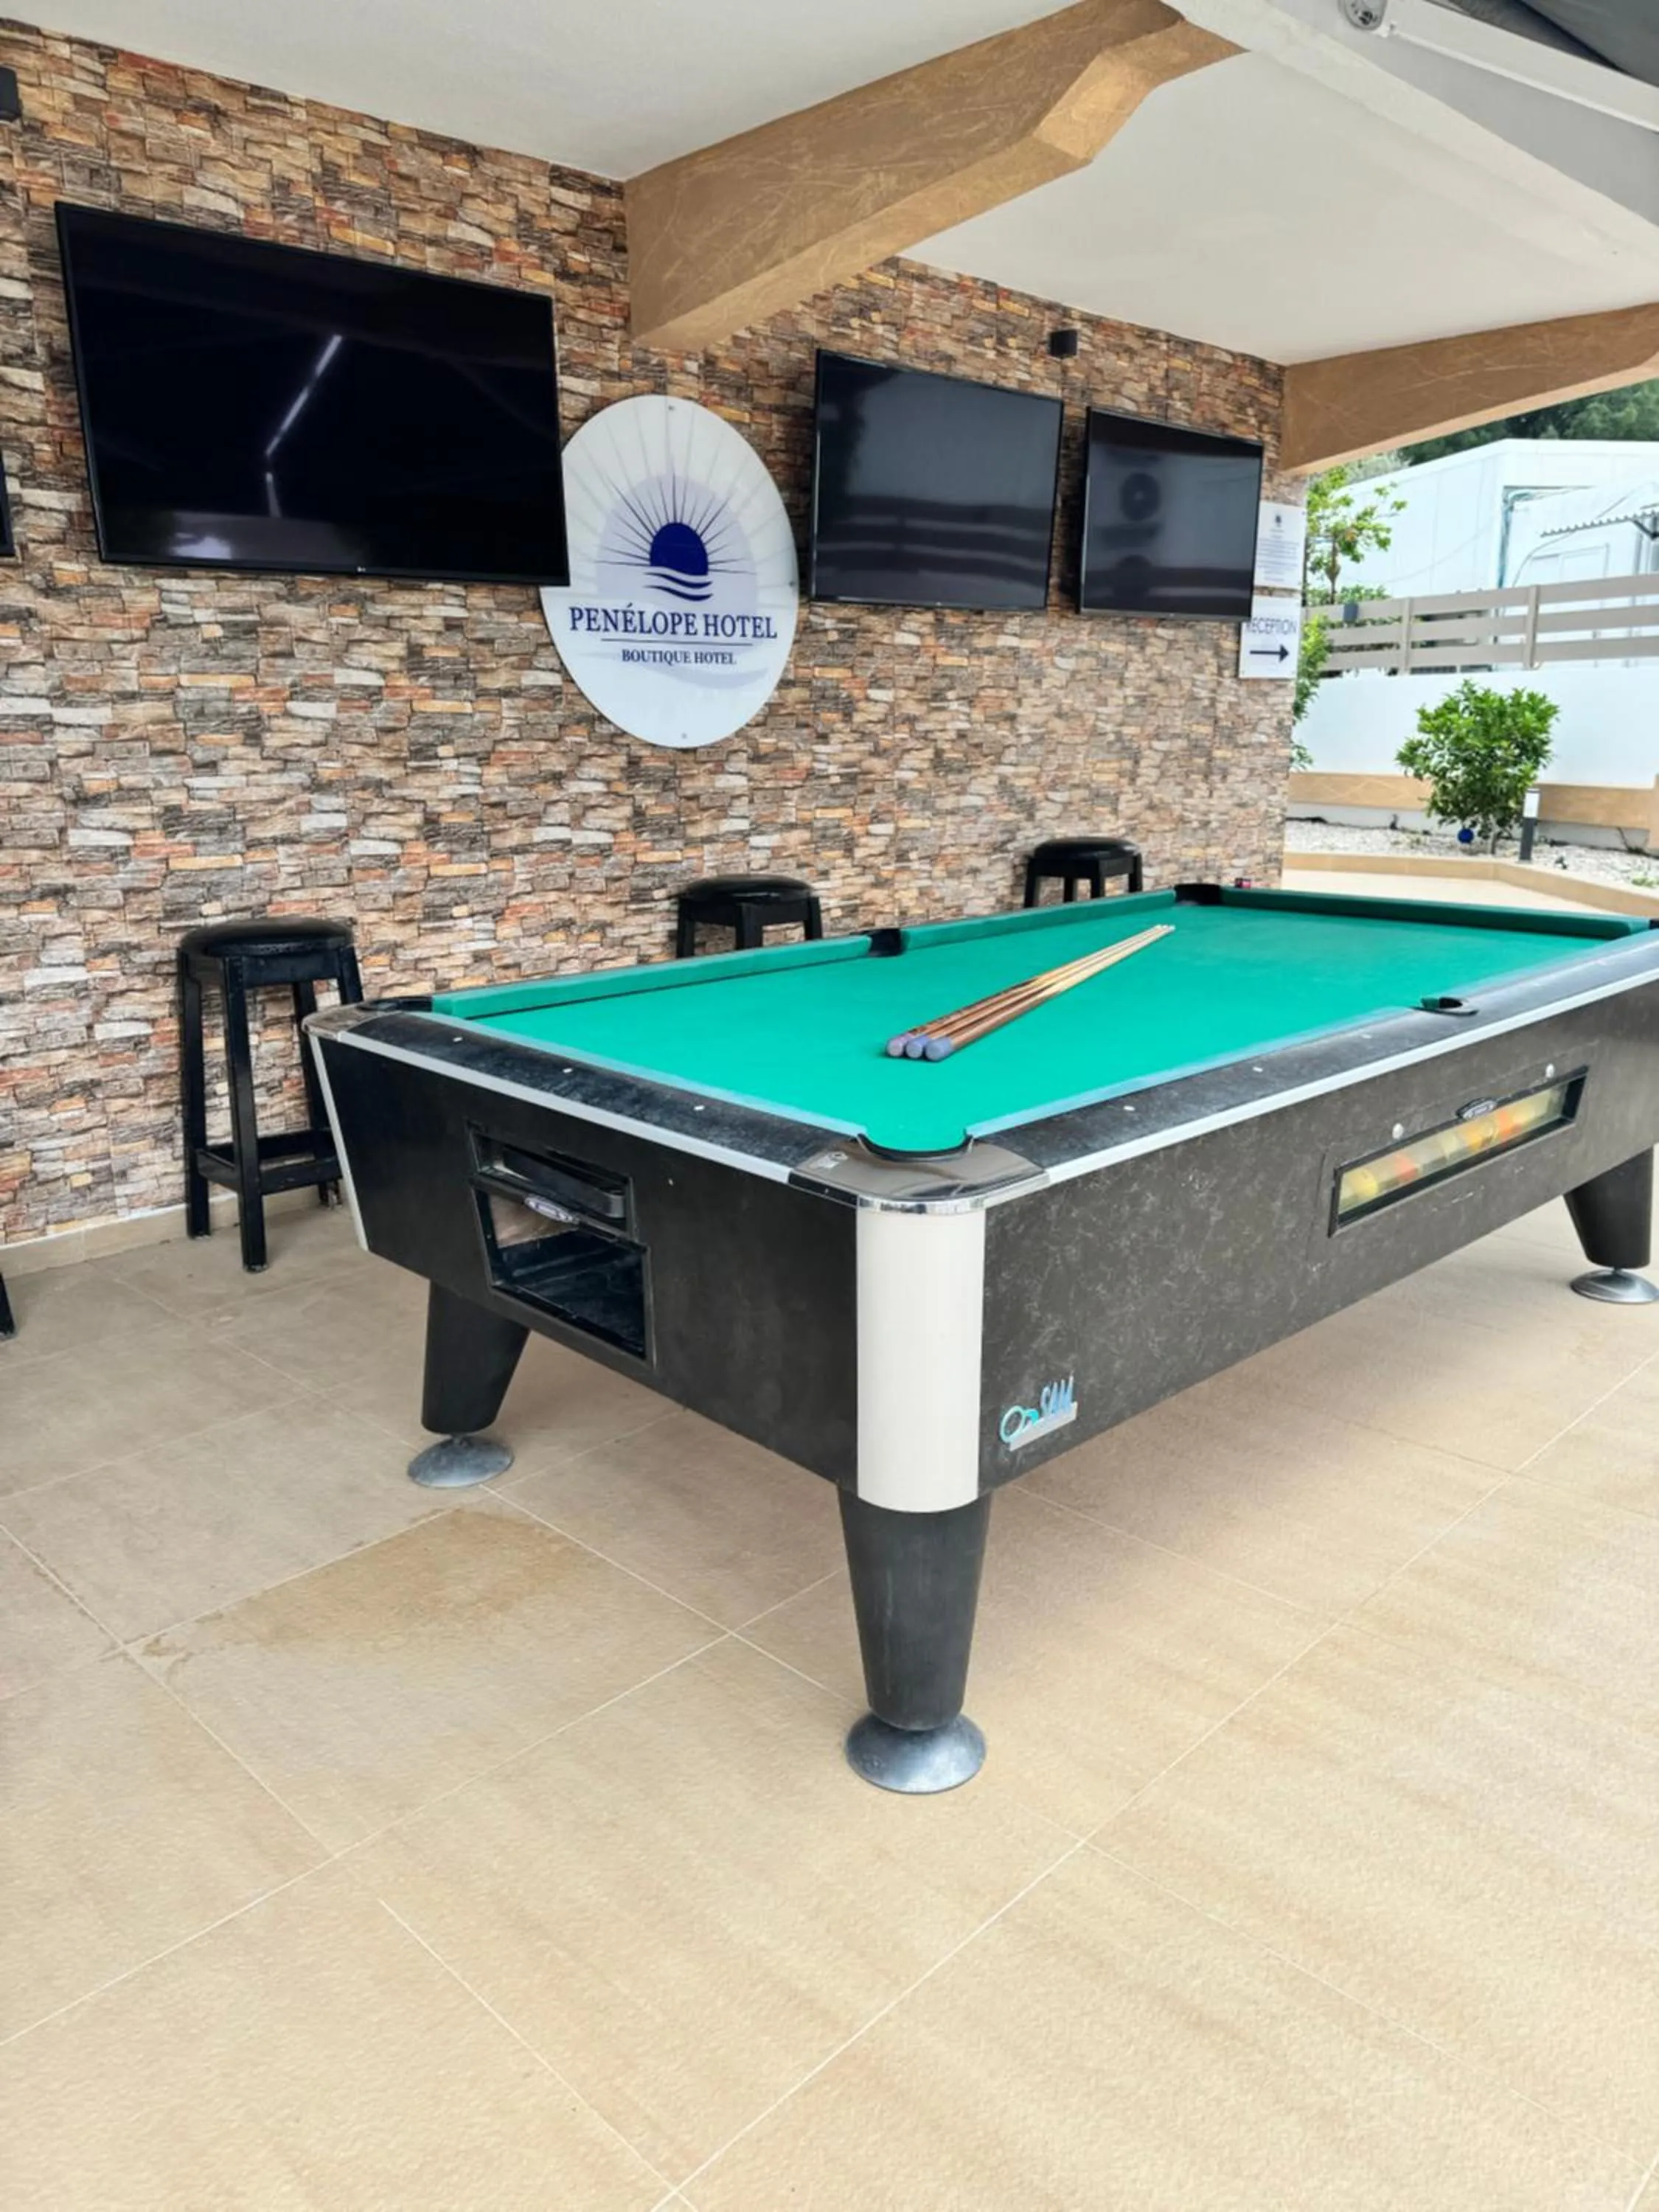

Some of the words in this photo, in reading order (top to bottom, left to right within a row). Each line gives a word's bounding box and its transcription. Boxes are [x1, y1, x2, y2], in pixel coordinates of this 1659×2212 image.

[569, 602, 698, 636] PENÉLOPE
[703, 613, 777, 639] HOTEL
[622, 649, 691, 666] BOUTIQUE
[694, 653, 737, 664] HOTEL
